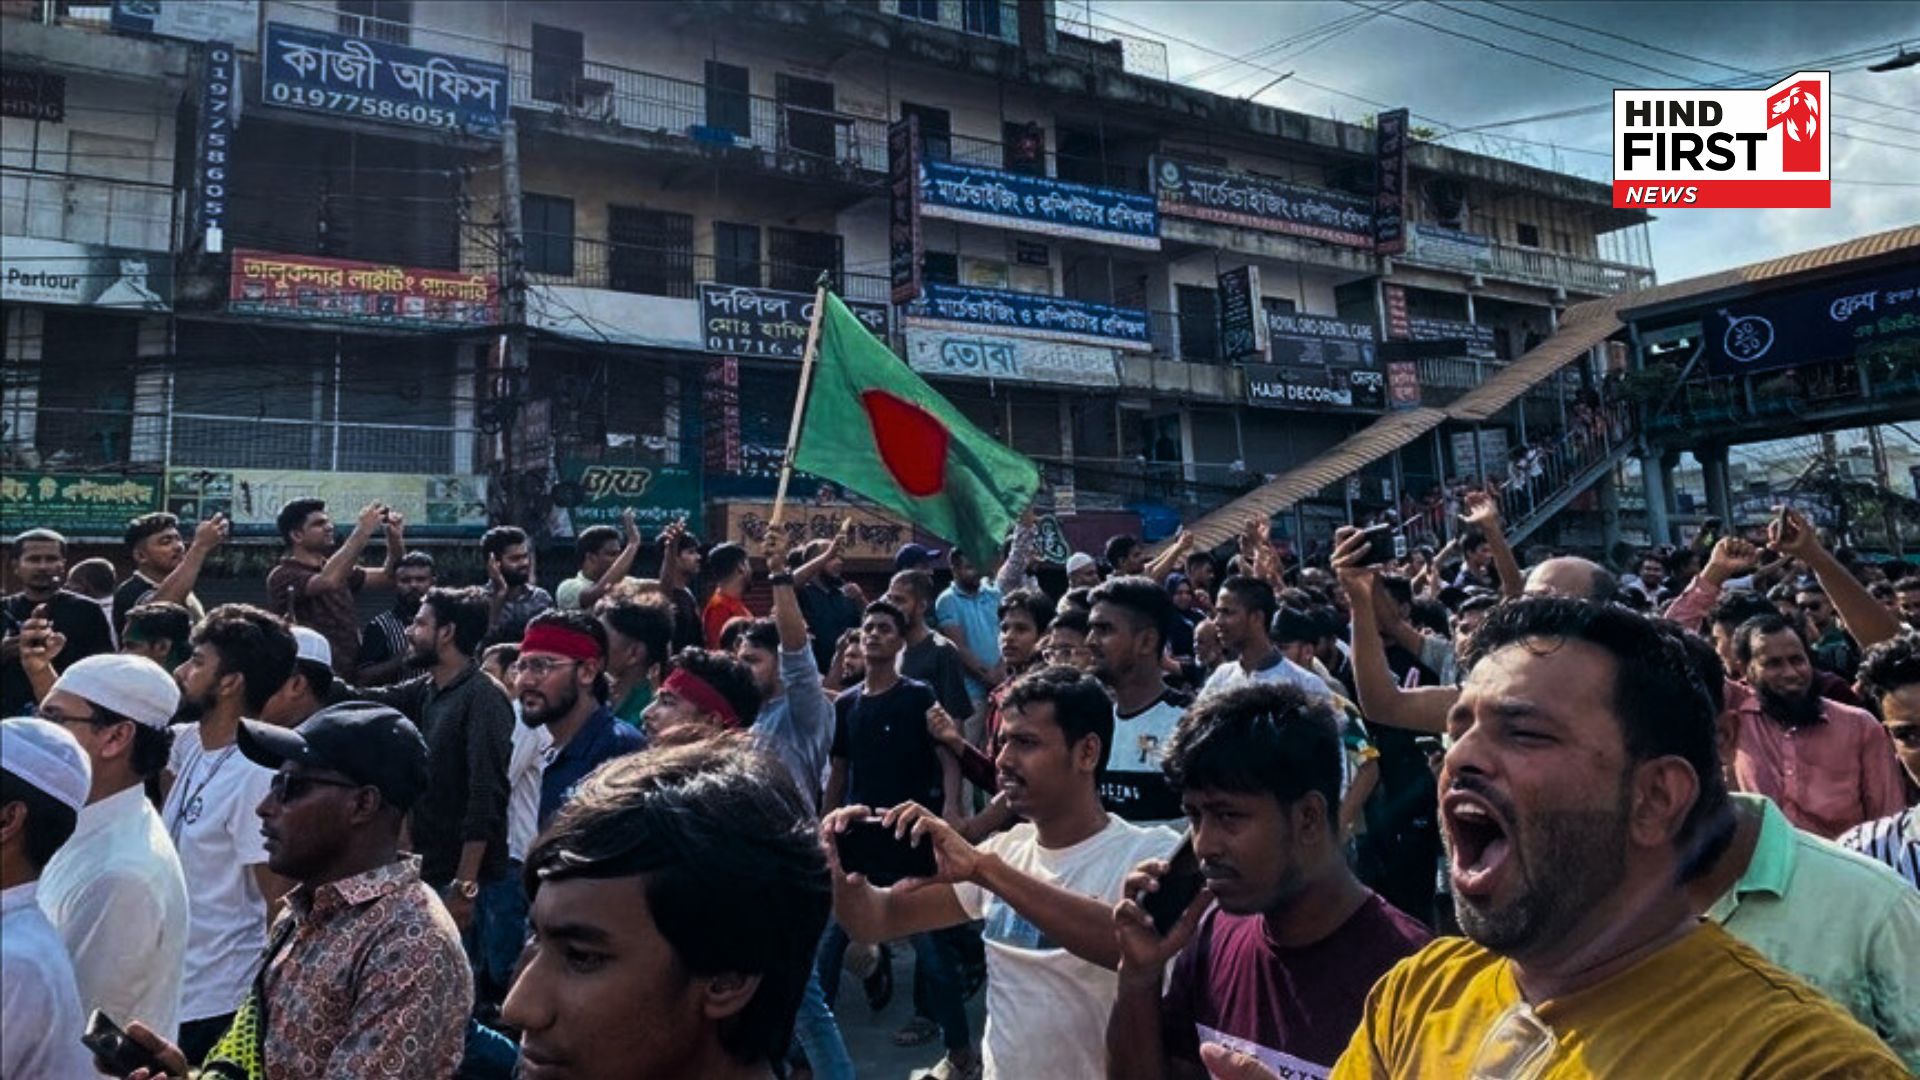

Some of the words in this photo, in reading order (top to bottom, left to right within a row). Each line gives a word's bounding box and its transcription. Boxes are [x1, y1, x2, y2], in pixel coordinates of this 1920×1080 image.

[277, 40, 382, 91] কাজী
[389, 57, 501, 110] অফিস
[272, 82, 457, 129] 01977586051
[706, 287, 791, 319] দলিল
[1250, 381, 1285, 398] HAIR
